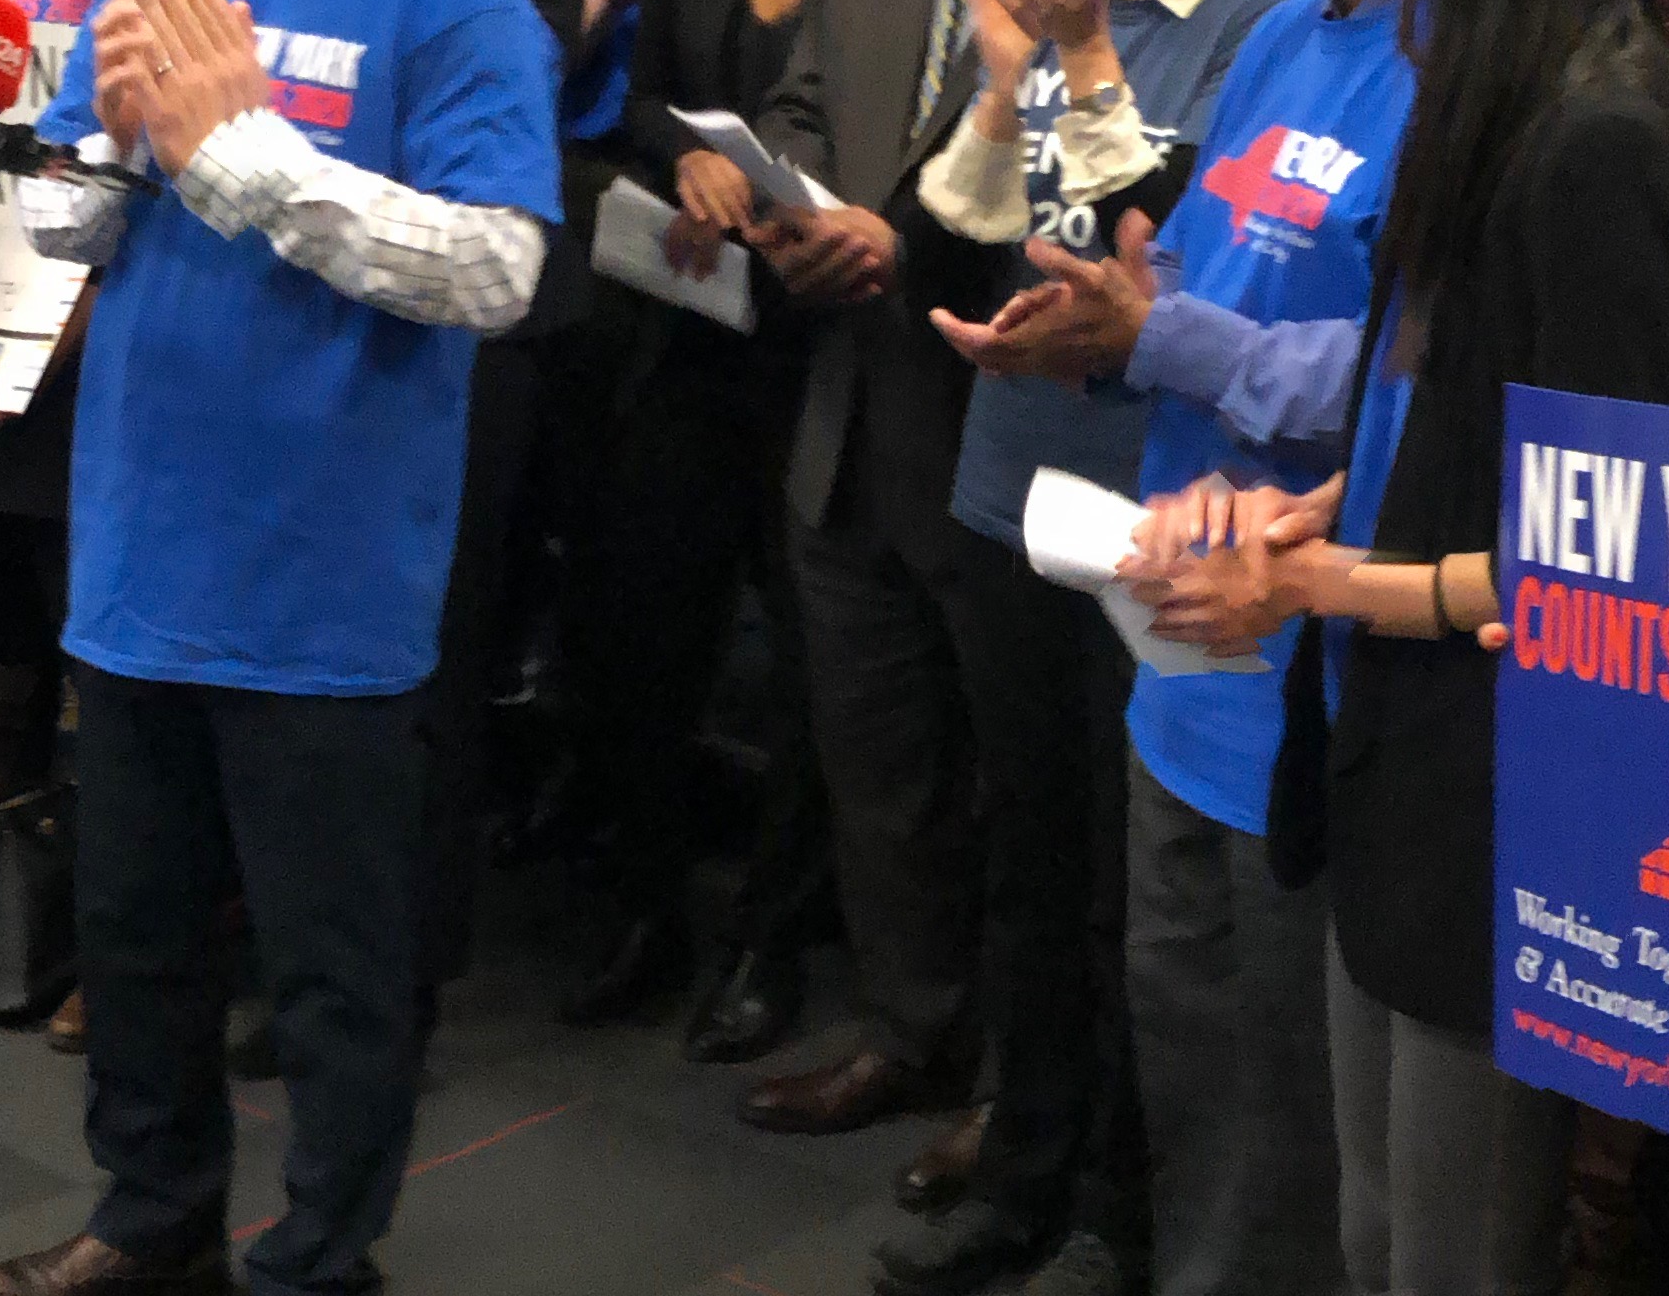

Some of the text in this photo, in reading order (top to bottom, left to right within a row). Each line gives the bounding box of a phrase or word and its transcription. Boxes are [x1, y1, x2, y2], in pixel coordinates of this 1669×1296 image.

[1517, 442, 1647, 583] NEW
[1513, 887, 1623, 969] Working
[1515, 946, 1544, 983] &
